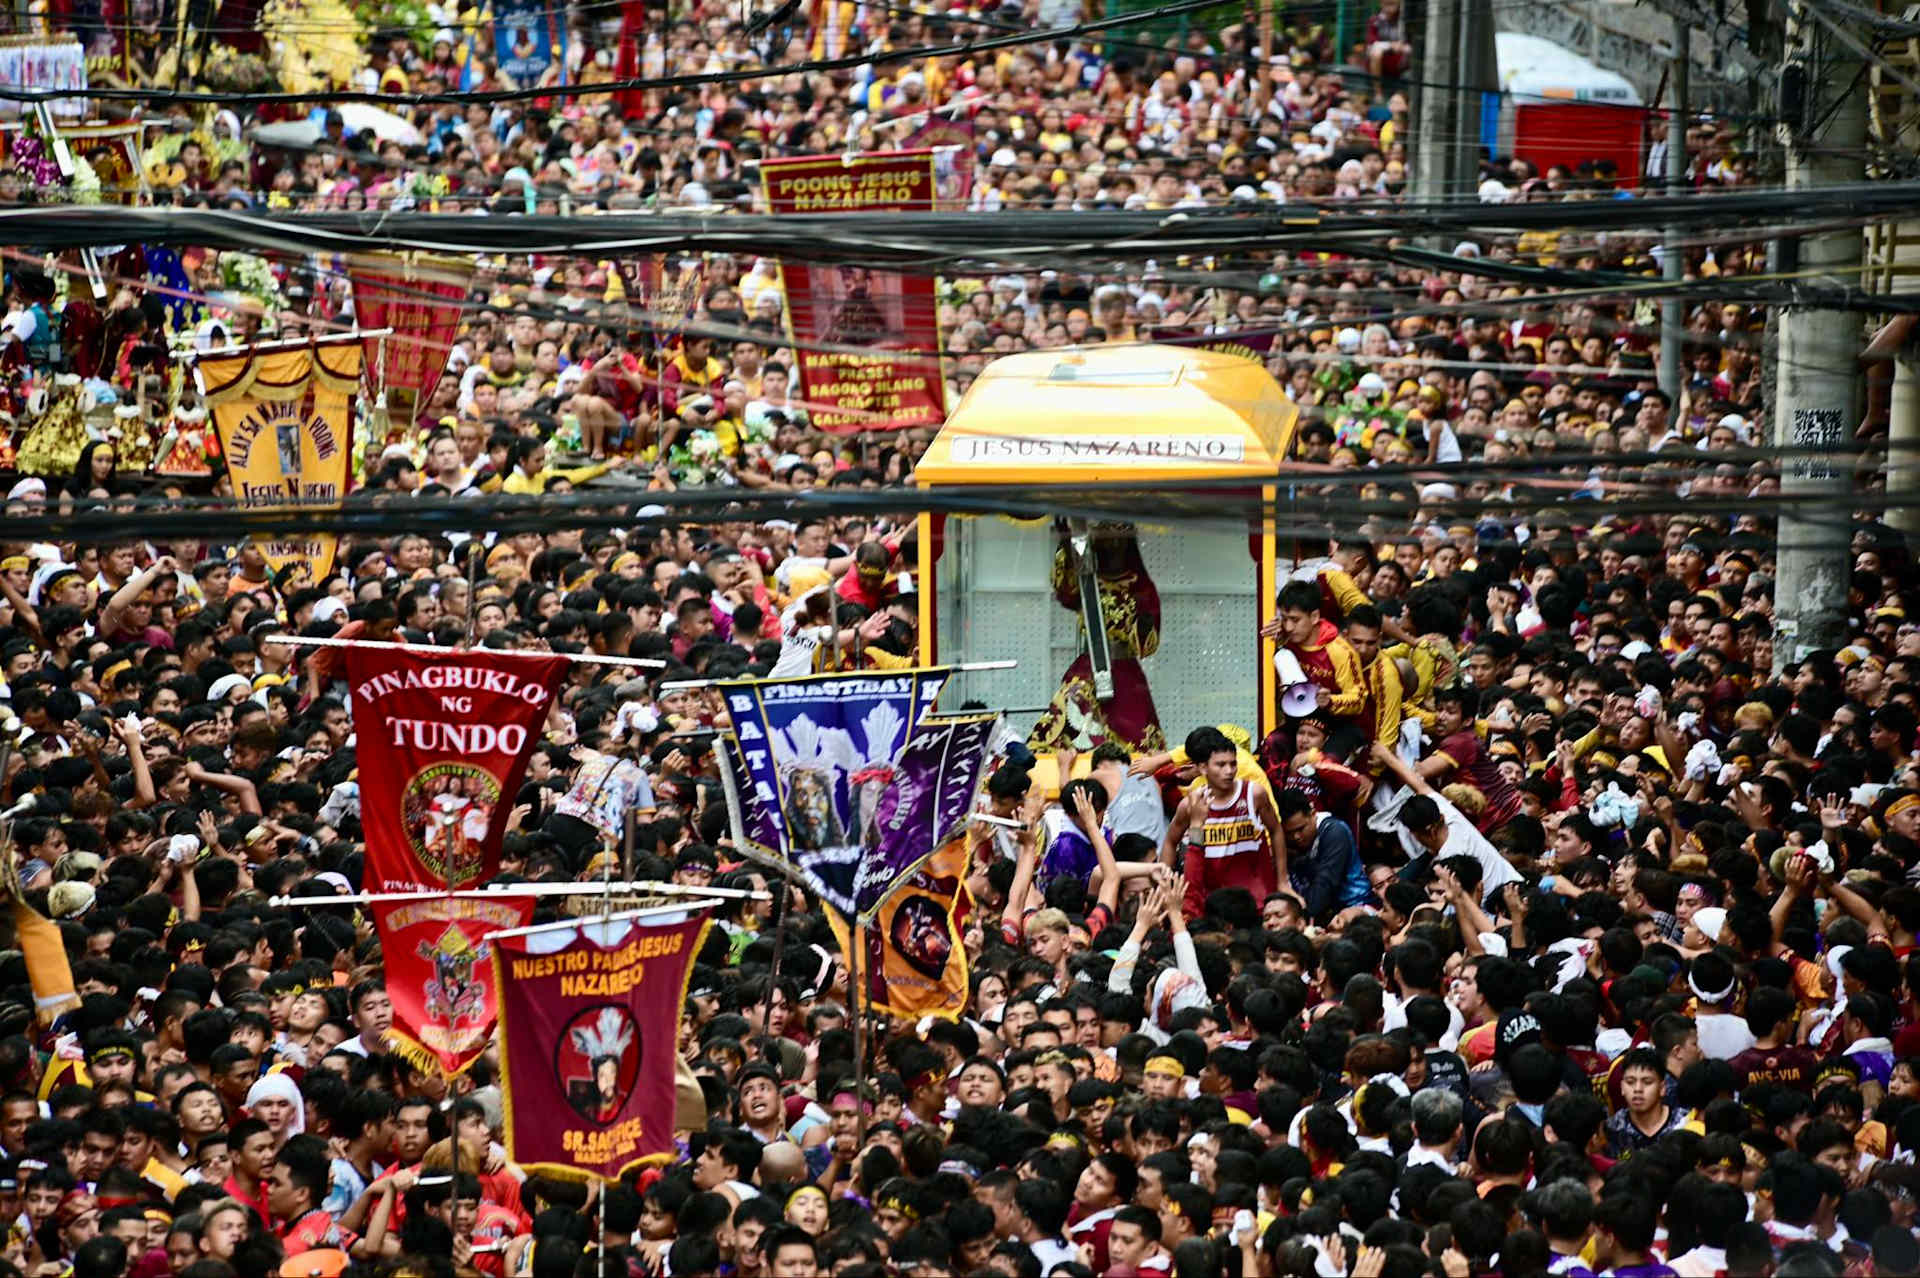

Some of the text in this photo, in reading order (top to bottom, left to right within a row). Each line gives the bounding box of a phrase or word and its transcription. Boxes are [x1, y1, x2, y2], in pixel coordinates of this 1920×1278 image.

[779, 170, 921, 195] POONG JESUS
[874, 377, 926, 393] SILANG
[892, 406, 930, 421] CITY
[969, 439, 1225, 459] JESUS NAZARENO
[241, 481, 284, 509] JESUS
[440, 695, 473, 713] NG
[385, 715, 528, 756] TUNDO
[511, 950, 589, 980] NUESTRO
[636, 932, 685, 959] JESUS
